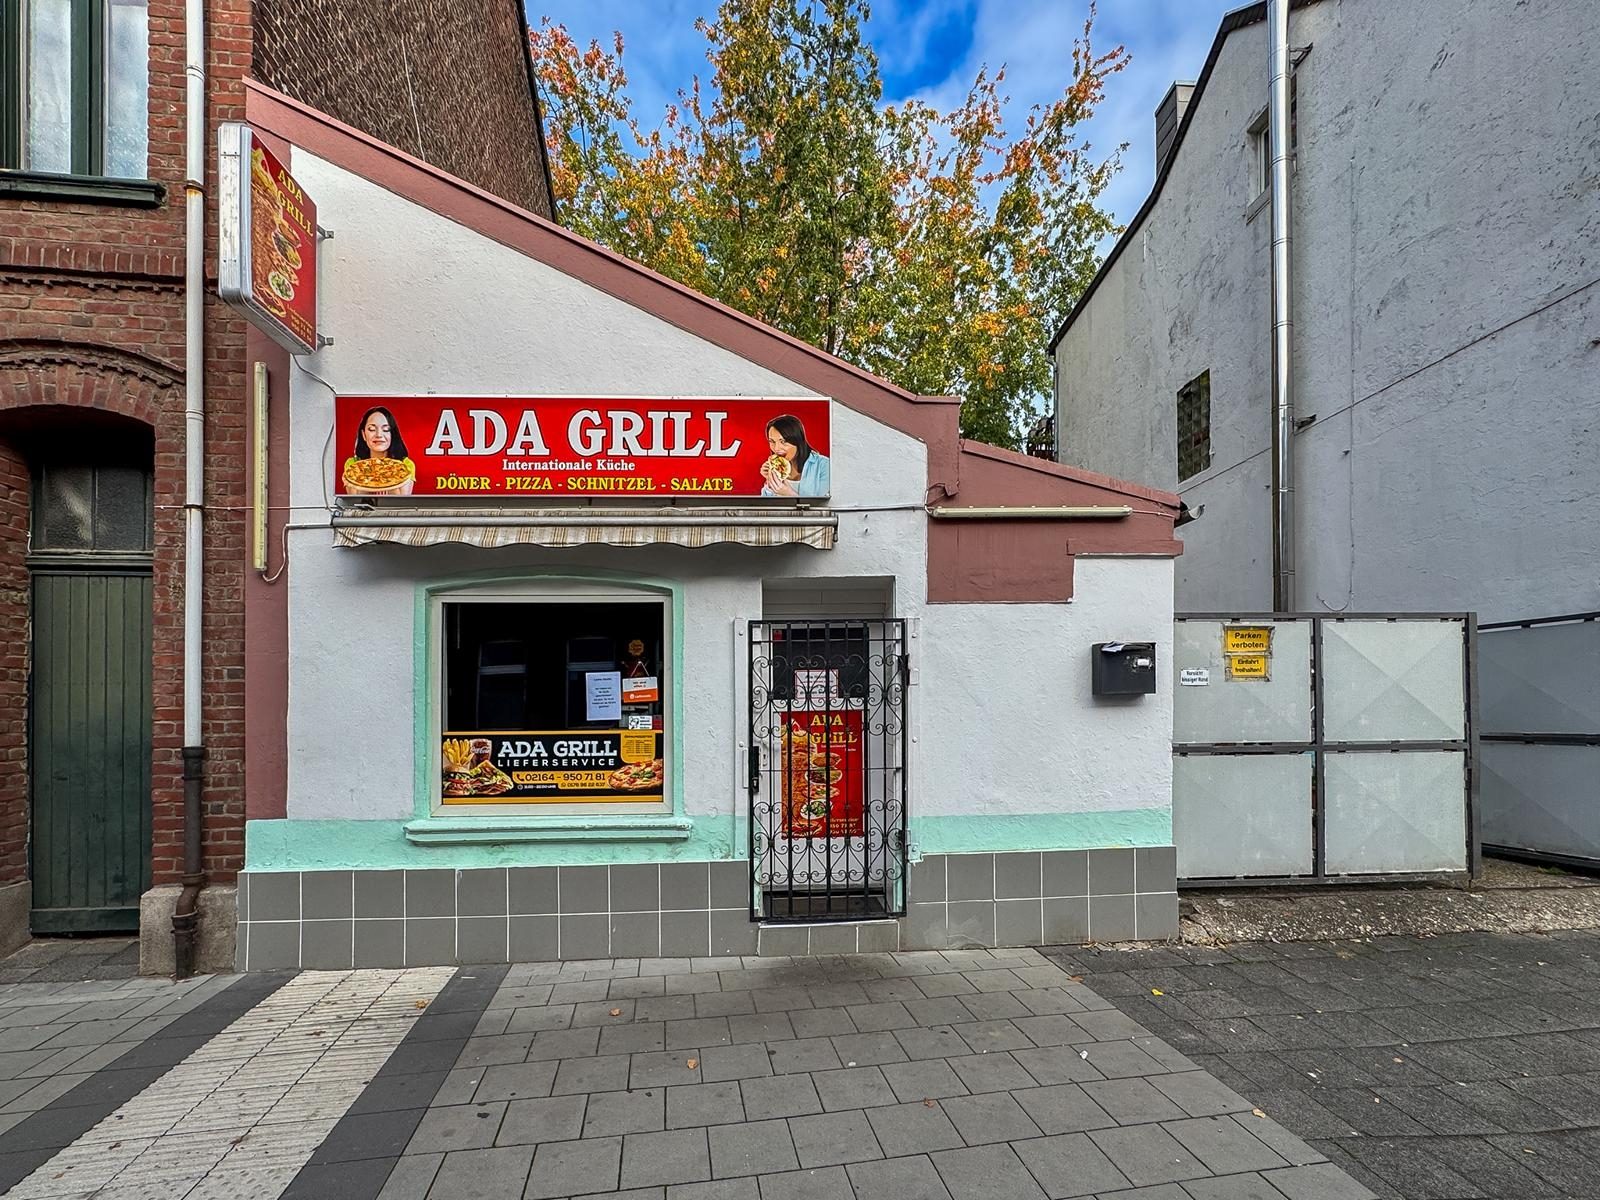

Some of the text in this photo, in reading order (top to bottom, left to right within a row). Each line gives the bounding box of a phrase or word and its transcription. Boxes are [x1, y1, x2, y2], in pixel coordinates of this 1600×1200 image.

[277, 169, 305, 206] ADA
[277, 191, 314, 237] GRILL
[425, 408, 742, 457] ADA GRILL
[502, 459, 636, 471] Internationale Küche
[436, 473, 491, 490] DÖNER
[505, 477, 553, 490] PIZZA
[567, 477, 656, 491] SCHNITZEL
[671, 477, 733, 491] SALATE
[810, 714, 844, 726] ADA
[498, 741, 548, 757] ADA
[553, 740, 617, 757] GRILL
[497, 758, 615, 767] LIEFERSERVICE
[525, 773, 555, 782] 02164
[563, 773, 582, 781] 950
[585, 773, 593, 781] 71
[595, 772, 605, 781] 81
